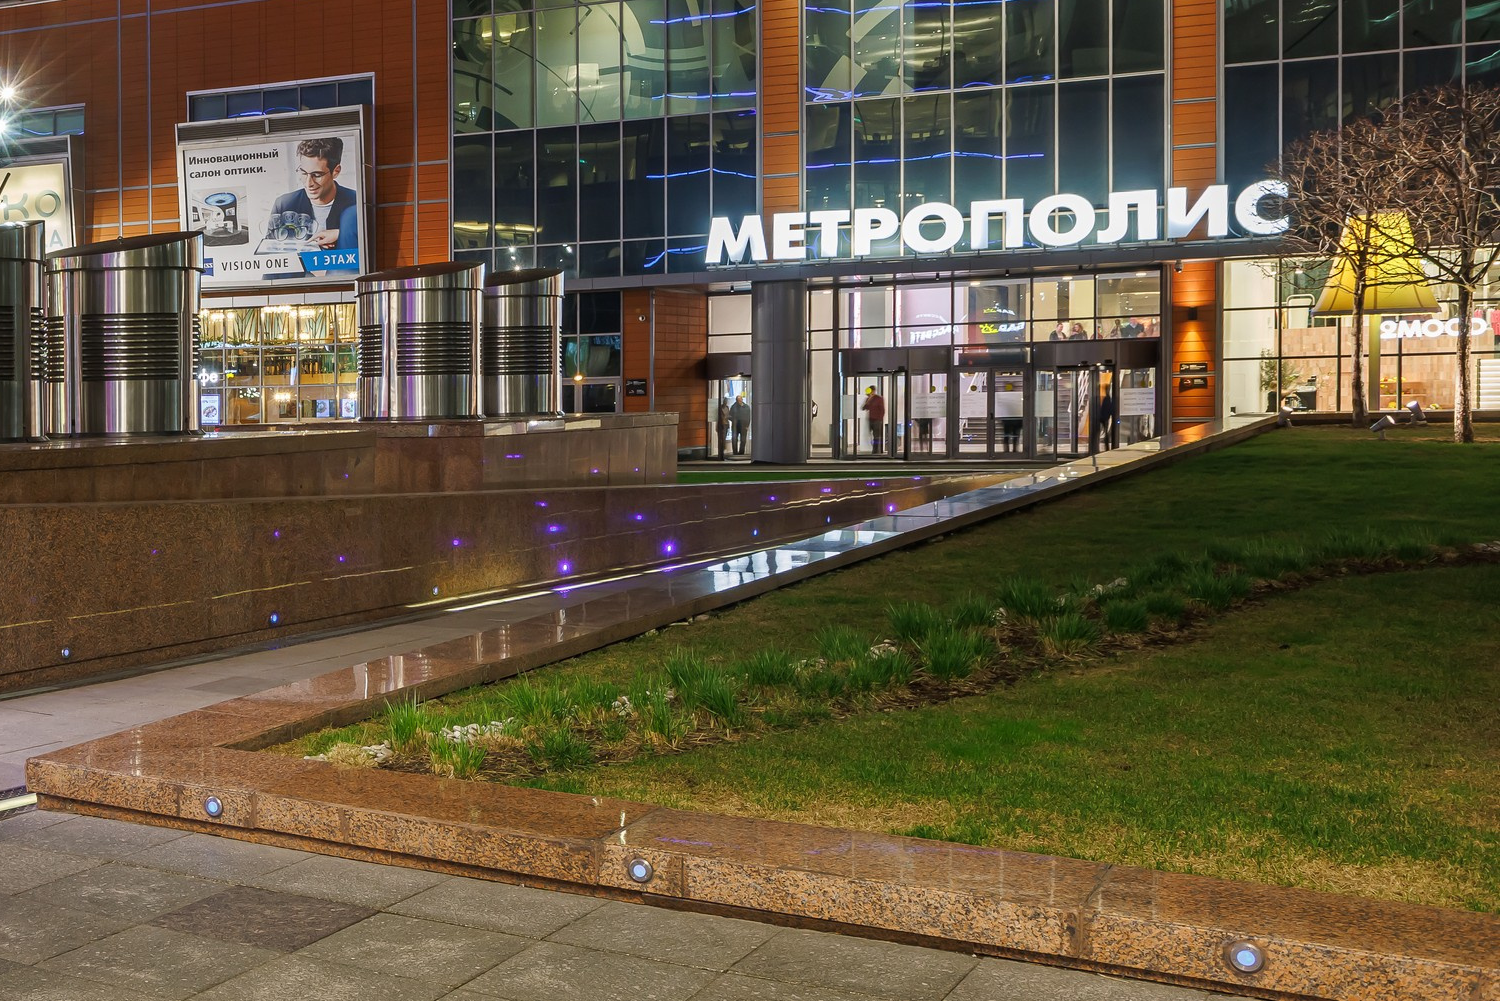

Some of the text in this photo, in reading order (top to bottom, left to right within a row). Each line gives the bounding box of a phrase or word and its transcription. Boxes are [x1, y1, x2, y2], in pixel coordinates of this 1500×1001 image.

[189, 149, 279, 166] Инновационный
[190, 165, 267, 179] салон оптики.
[705, 179, 1290, 264] МЕТРОПОЛИС
[222, 259, 261, 271] VISION
[266, 258, 289, 270] ONE
[313, 253, 357, 266] 1 ЭТАЖ
